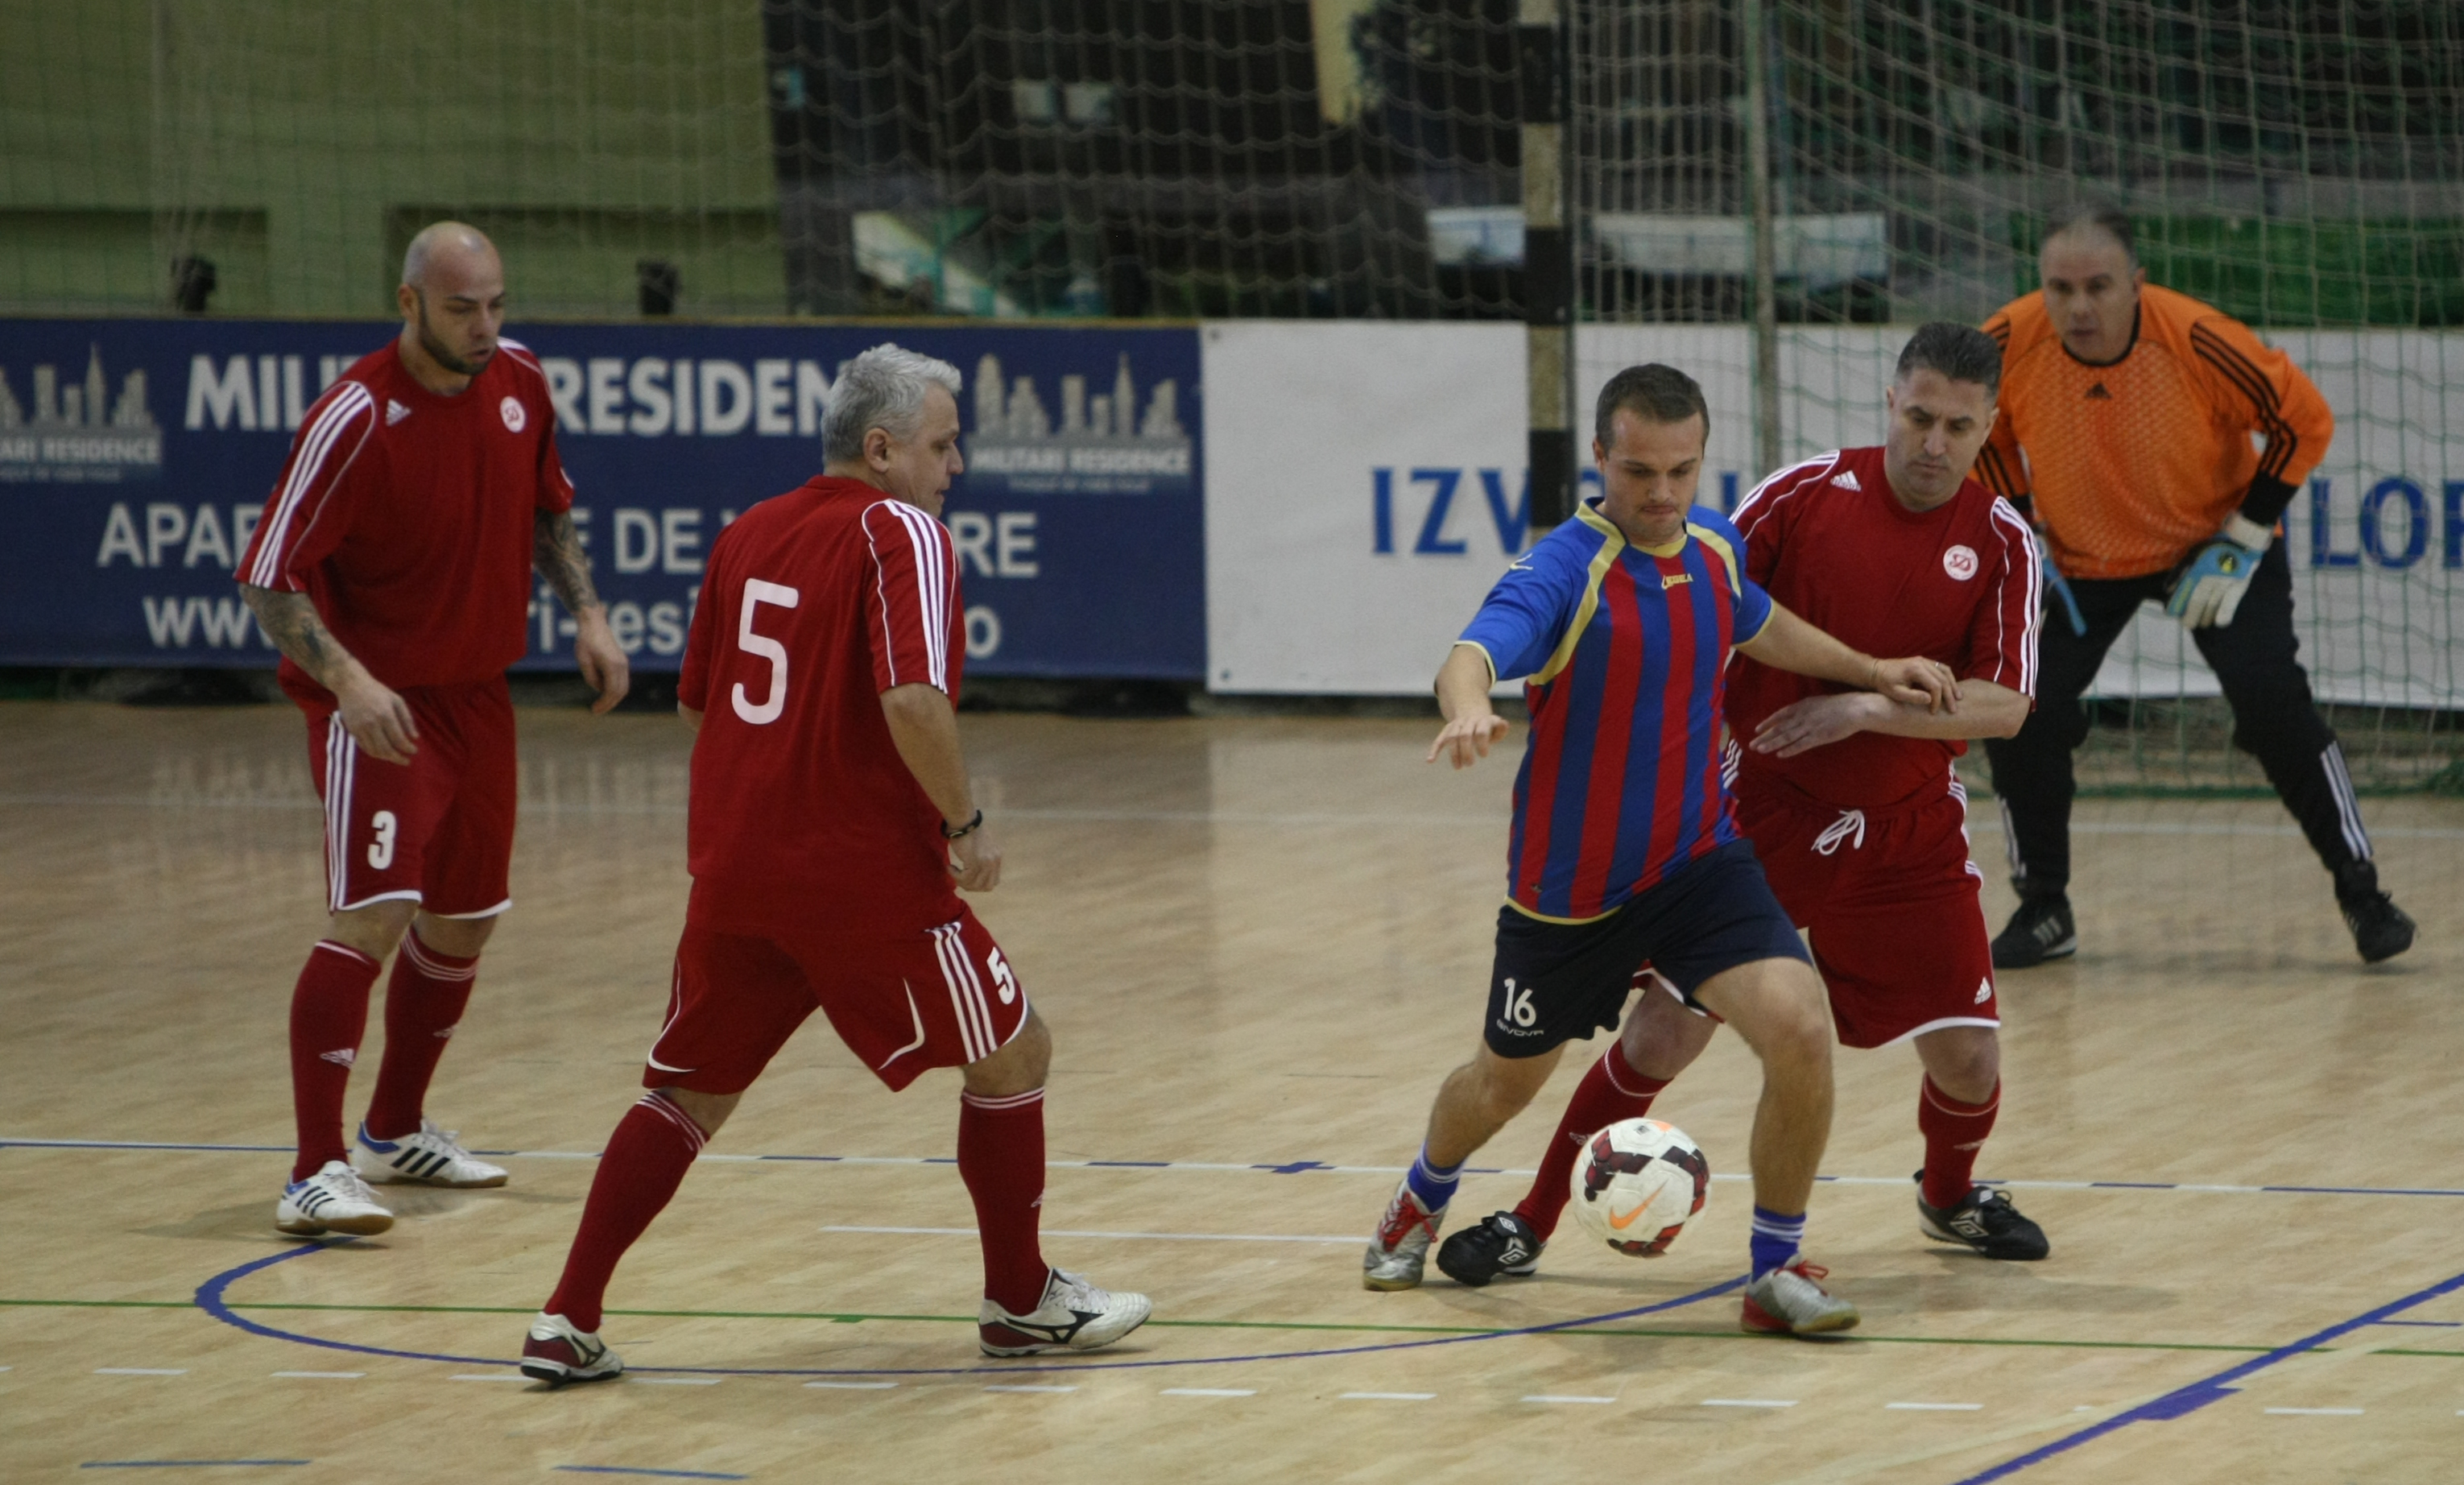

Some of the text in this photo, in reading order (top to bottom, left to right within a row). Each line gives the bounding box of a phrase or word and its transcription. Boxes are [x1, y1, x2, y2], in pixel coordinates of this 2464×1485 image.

[614, 508, 704, 574] DE
[731, 577, 799, 725] 5
[367, 810, 397, 871] 3
[986, 946, 1015, 1005] 5
[1503, 977, 1537, 1028] 16
